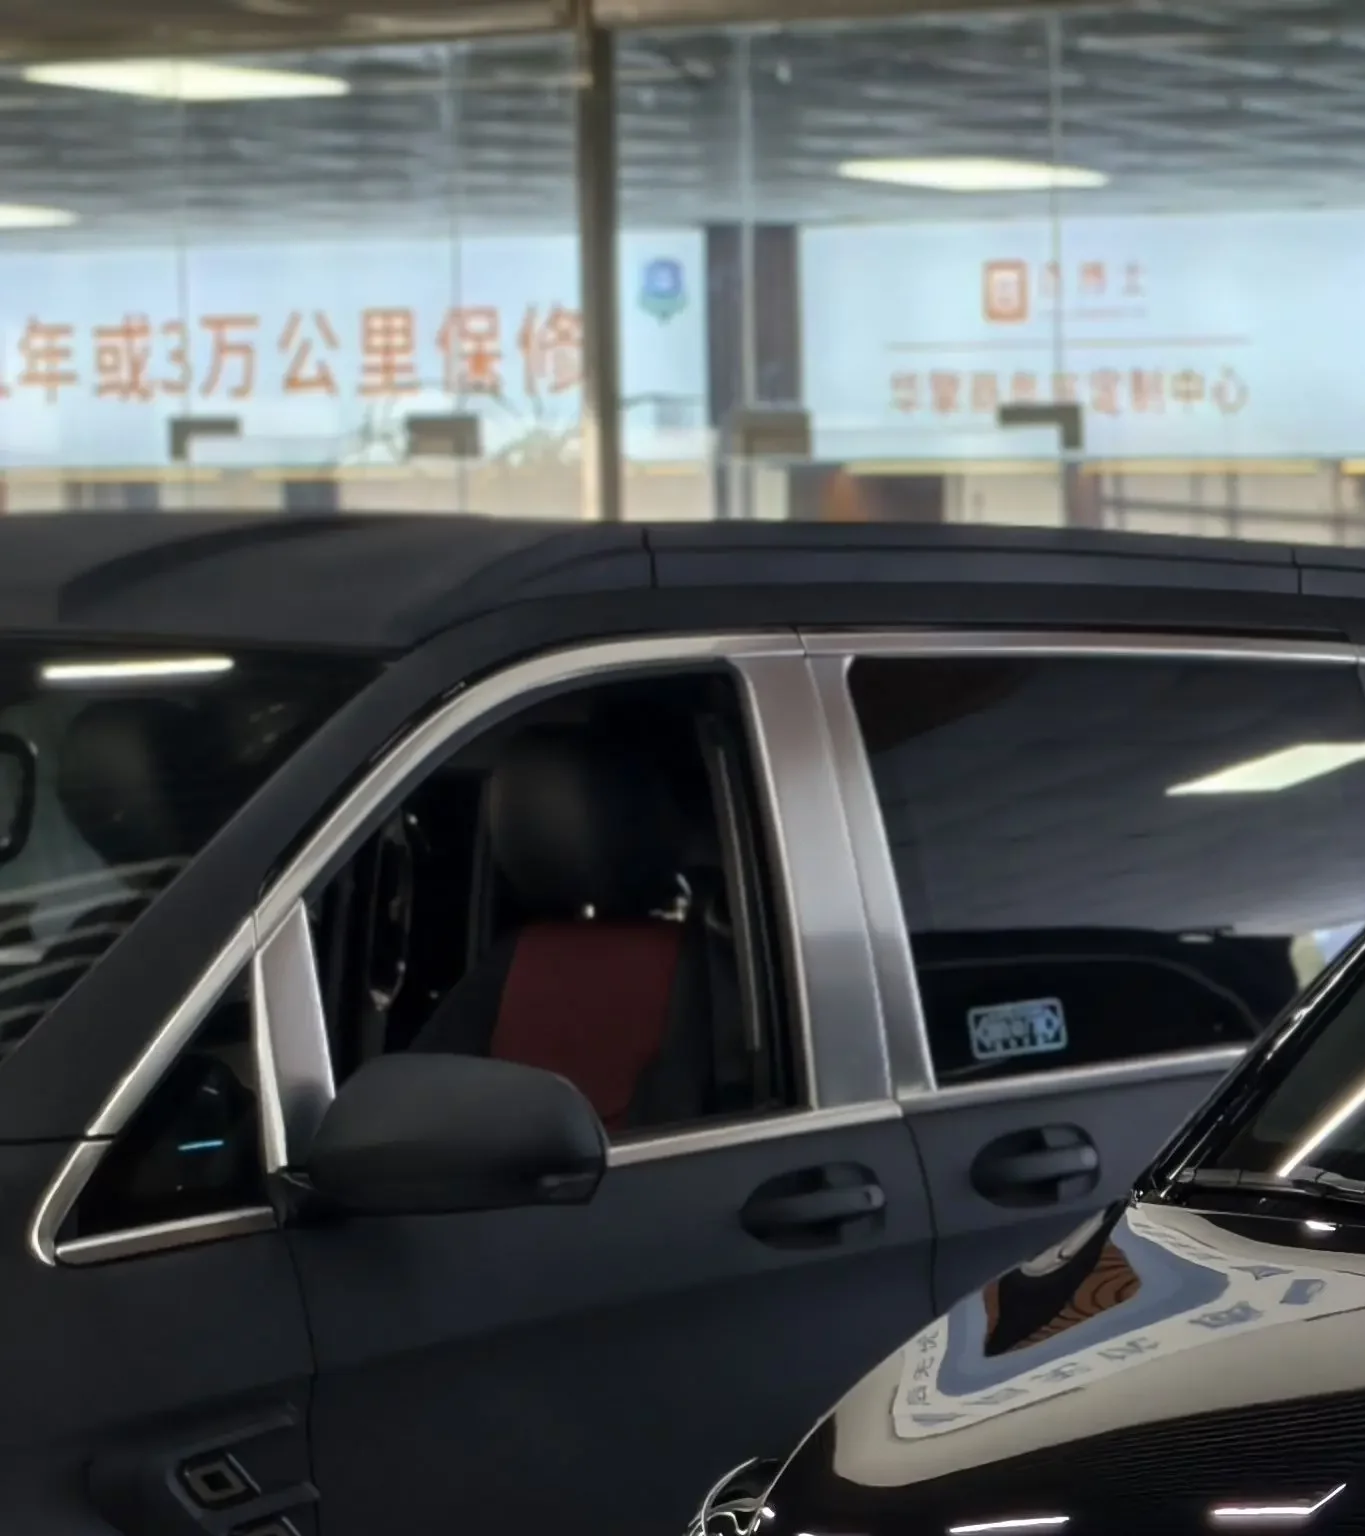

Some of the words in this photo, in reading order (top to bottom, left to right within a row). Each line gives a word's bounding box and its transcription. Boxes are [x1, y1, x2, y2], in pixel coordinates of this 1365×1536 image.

[0, 302, 583, 404] 年或3万公里保修
